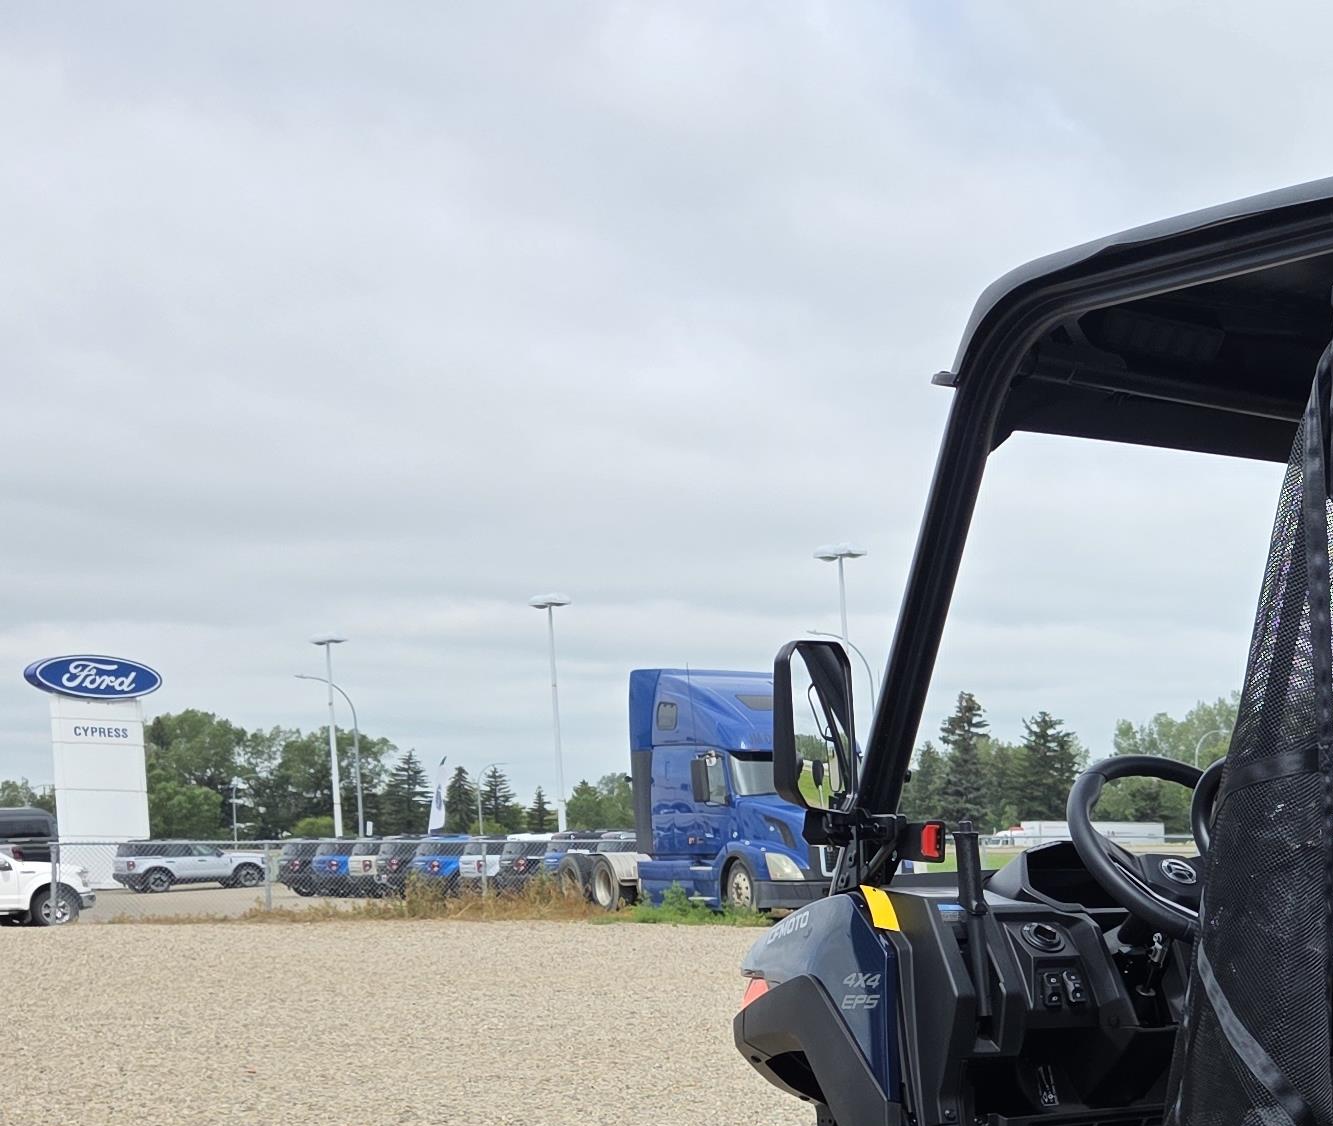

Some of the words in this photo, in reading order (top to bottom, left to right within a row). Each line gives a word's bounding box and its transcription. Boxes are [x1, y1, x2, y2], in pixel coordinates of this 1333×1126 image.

[61, 660, 137, 692] Ford
[73, 725, 129, 739] CYPRESS
[766, 910, 810, 945] CFMOTO
[843, 972, 881, 989] 4X4
[841, 994, 881, 1010] EPS
